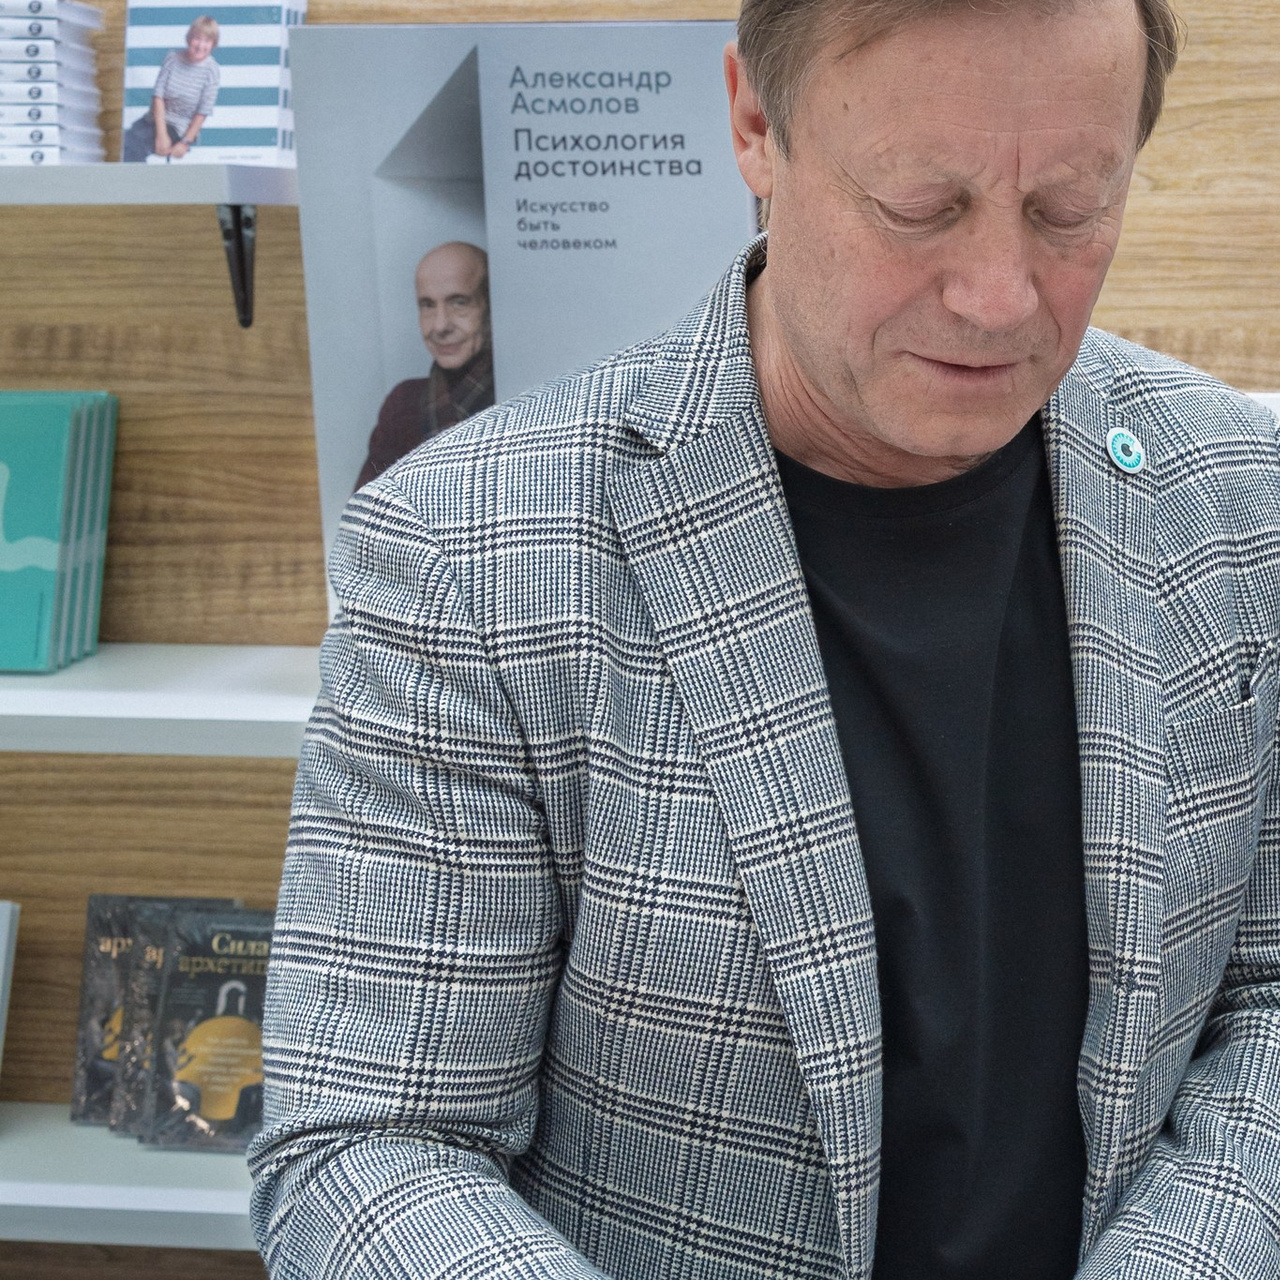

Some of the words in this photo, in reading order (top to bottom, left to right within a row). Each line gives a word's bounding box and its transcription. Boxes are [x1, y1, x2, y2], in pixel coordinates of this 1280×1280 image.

[509, 66, 672, 94] Александр
[510, 91, 640, 115] Асмолов
[513, 127, 686, 152] Психология
[513, 158, 703, 181] достоинства
[515, 198, 610, 216] Искусство
[516, 217, 561, 232] быть
[516, 238, 618, 251] человеком
[212, 932, 270, 957] Сила
